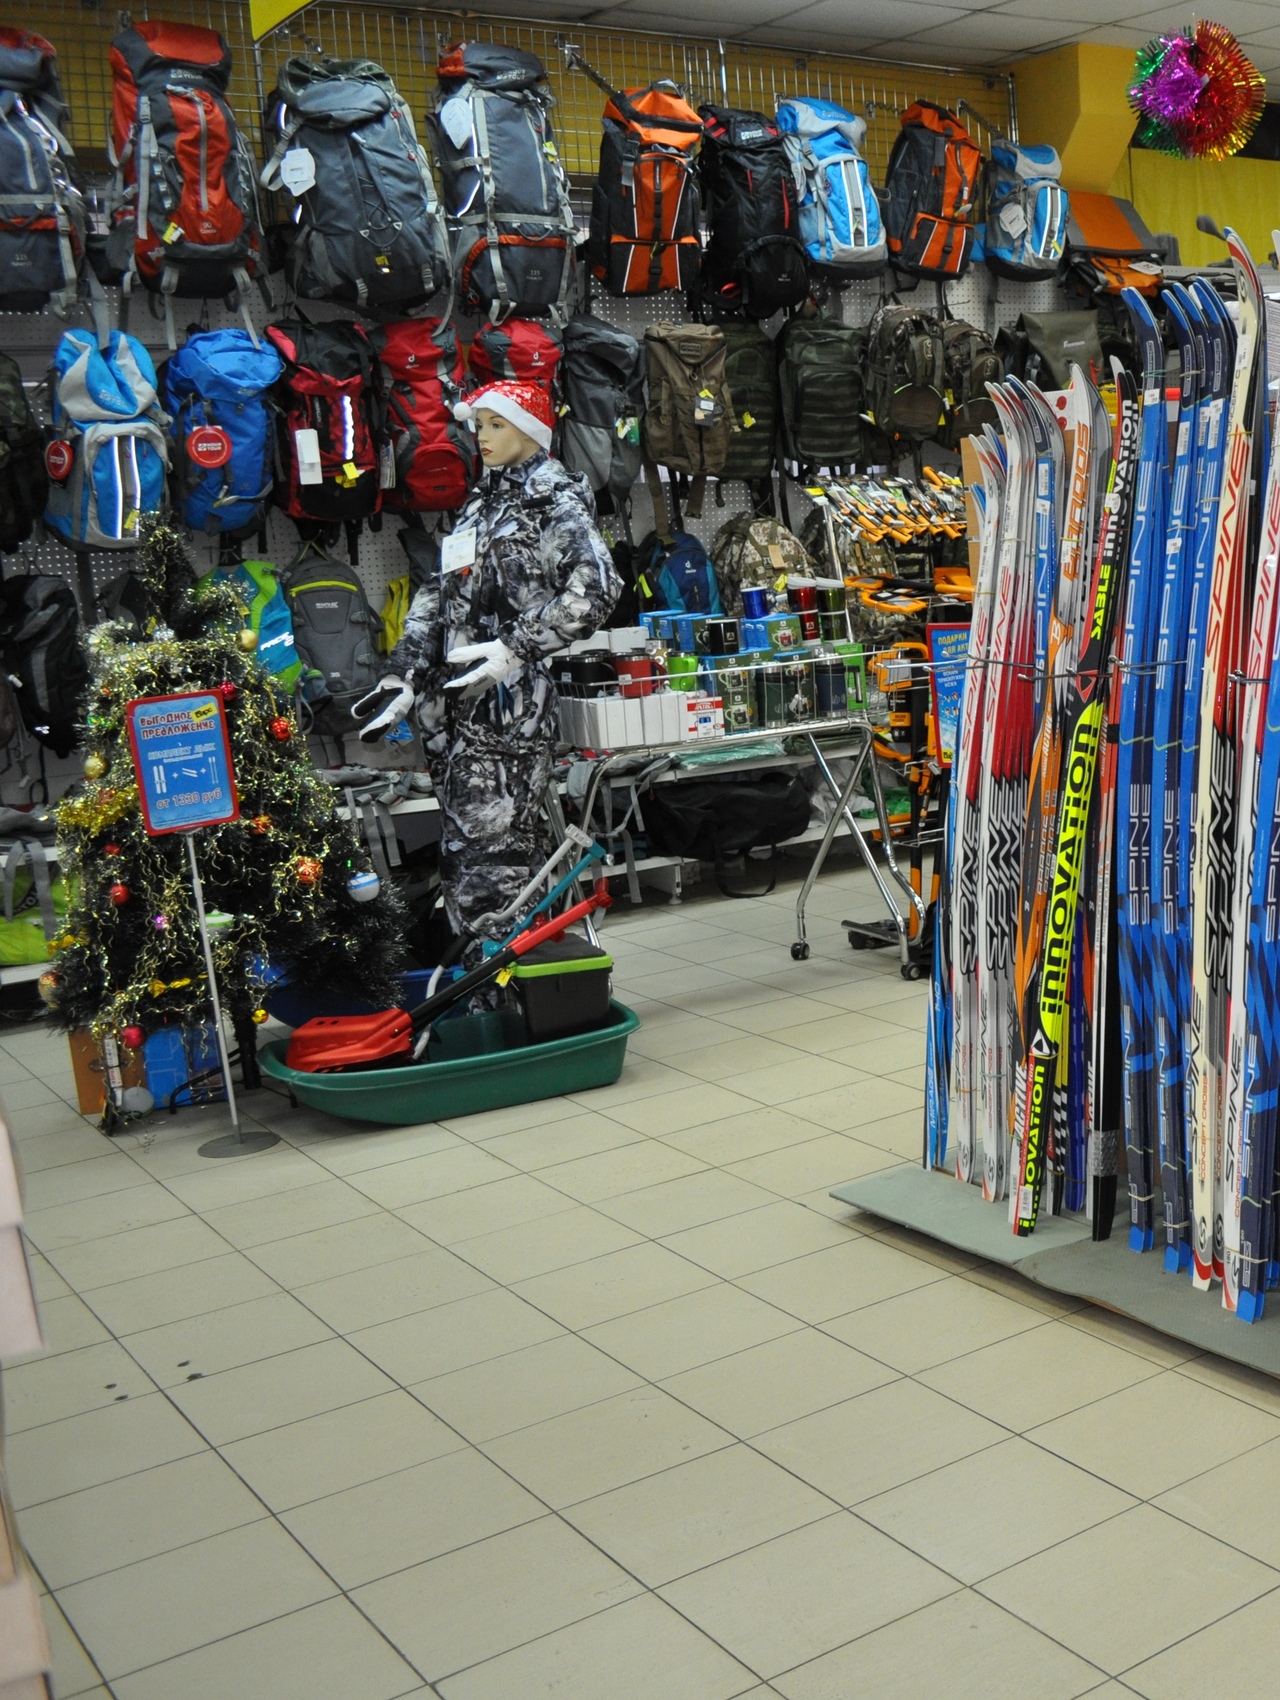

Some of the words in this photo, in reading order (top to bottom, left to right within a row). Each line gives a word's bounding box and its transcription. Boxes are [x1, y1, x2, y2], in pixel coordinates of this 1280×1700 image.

[1090, 564, 1112, 640] SABLE
[1121, 461, 1151, 684] SPINE
[1184, 460, 1218, 691] SPINE
[1204, 424, 1250, 675] SPINE
[937, 631, 968, 645] ПОДАРКИ
[140, 711, 192, 727] ВЫГОДНОЕ
[142, 720, 215, 739] ПРЕДЛОЖЕНИЕ
[157, 799, 170, 809] от
[202, 788, 222, 805] руб
[1129, 783, 1140, 926] SPINE
[1203, 727, 1225, 998] SPINE
[1015, 1061, 1027, 1140] ACTIVE
[1226, 1030, 1240, 1184] SPINE
[1242, 1034, 1256, 1177] SPINE
